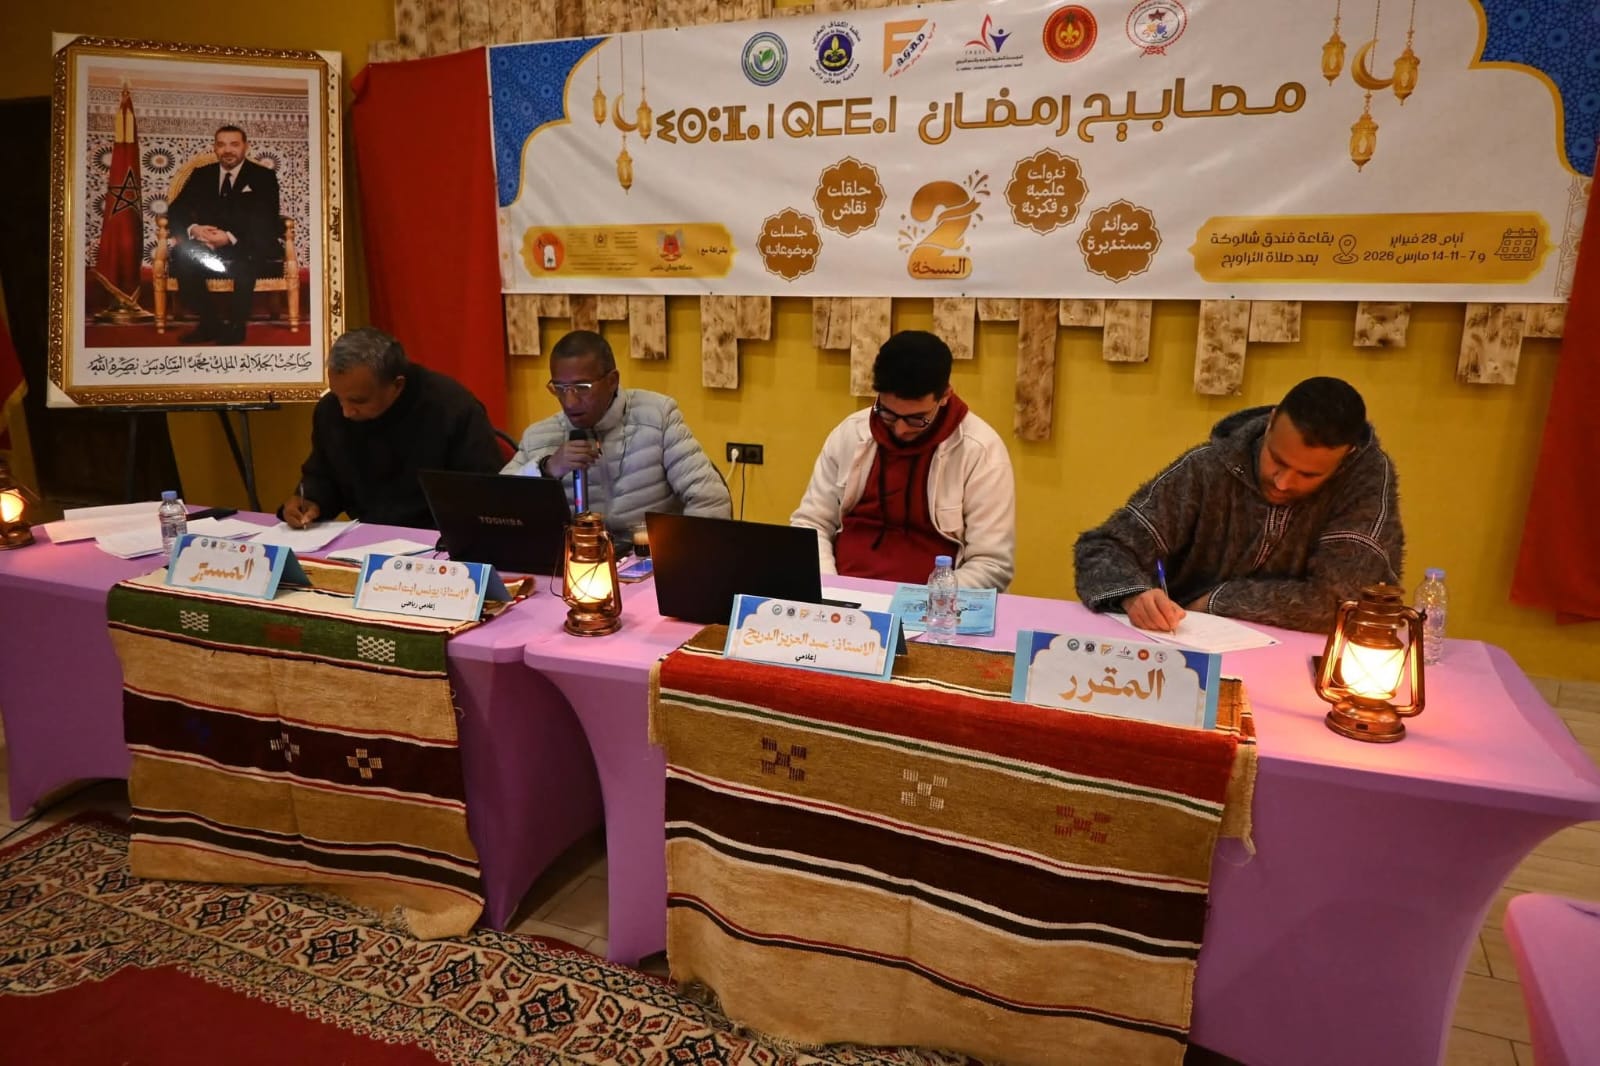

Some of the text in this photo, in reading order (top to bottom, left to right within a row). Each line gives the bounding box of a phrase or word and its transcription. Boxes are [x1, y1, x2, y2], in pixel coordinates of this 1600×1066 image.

[918, 78, 1307, 145] مصابيح رمضان
[1027, 164, 1066, 183] ندوات
[827, 180, 871, 197] حلقات
[832, 199, 867, 220] نقاش
[770, 225, 807, 240] جلسات
[1210, 231, 1335, 247] بقاعة فندق شالوكة
[1391, 233, 1419, 248] فبراير
[1421, 234, 1437, 244] 28
[1087, 236, 1152, 255] مستديرة
[1221, 252, 1319, 268] بعد صلاة التراويح
[1396, 251, 1430, 264] مارس
[912, 258, 966, 275] النسخة
[1058, 666, 1166, 703] المقرر
